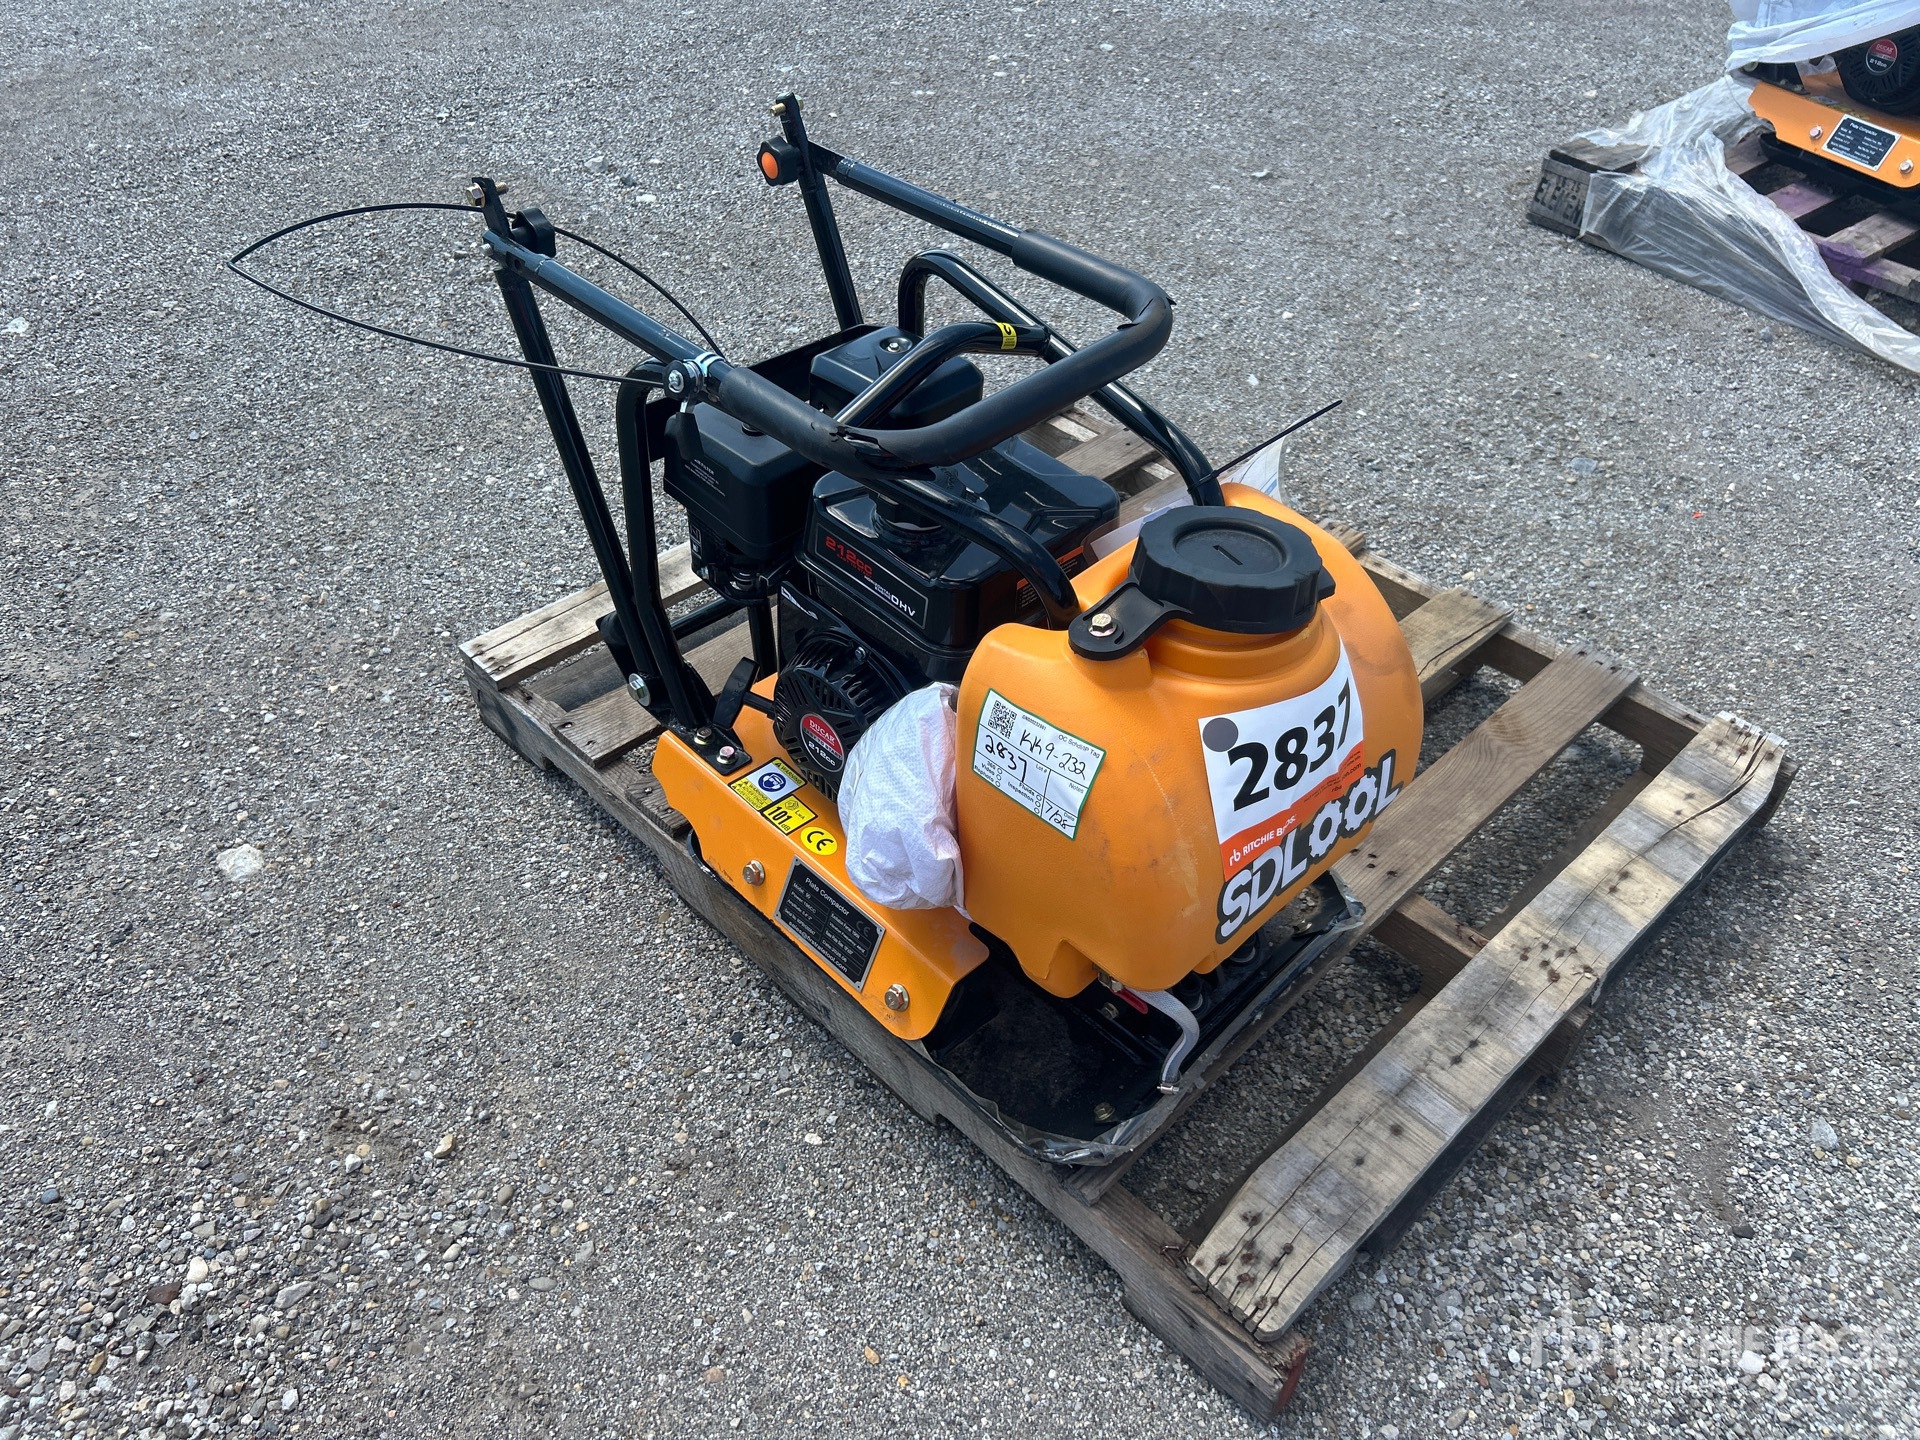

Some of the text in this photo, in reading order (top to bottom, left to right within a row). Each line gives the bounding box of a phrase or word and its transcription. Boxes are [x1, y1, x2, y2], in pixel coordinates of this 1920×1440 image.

[825, 535, 873, 577] 212cc
[891, 594, 916, 617] OHV
[809, 720, 836, 744] DUCAR
[808, 740, 836, 767] 212cc
[1058, 734, 1068, 743] OC
[1089, 749, 1101, 759] Tag
[1227, 677, 1351, 812] 2837
[981, 763, 996, 776] Video
[985, 734, 1028, 782] 2837
[1035, 763, 1045, 772] Lot
[781, 764, 803, 784] WARNING
[1007, 781, 1035, 803] Inspection
[1019, 782, 1035, 797] Fluids
[1069, 782, 1085, 794] Notes
[767, 806, 793, 825] 101
[1063, 811, 1075, 822] Date
[1242, 830, 1275, 857] RITCHIE
[805, 877, 820, 892] Plate
[820, 889, 850, 916] Compactor
